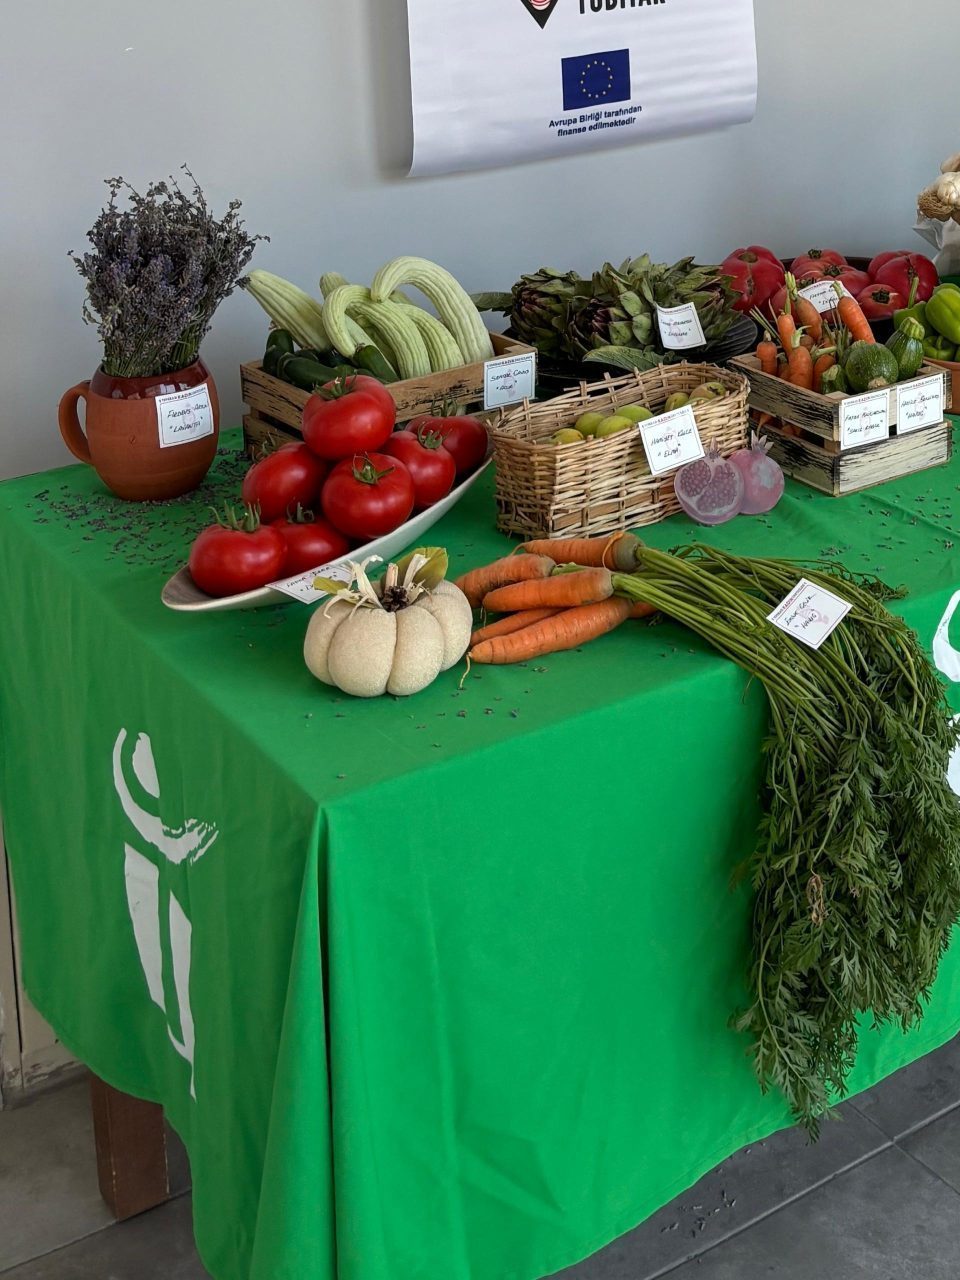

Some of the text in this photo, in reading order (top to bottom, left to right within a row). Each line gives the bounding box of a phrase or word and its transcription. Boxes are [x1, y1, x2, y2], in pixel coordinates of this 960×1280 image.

[549, 105, 642, 128] Avrupa Birliği tarafından
[557, 117, 636, 136] finanse edilmektedir
